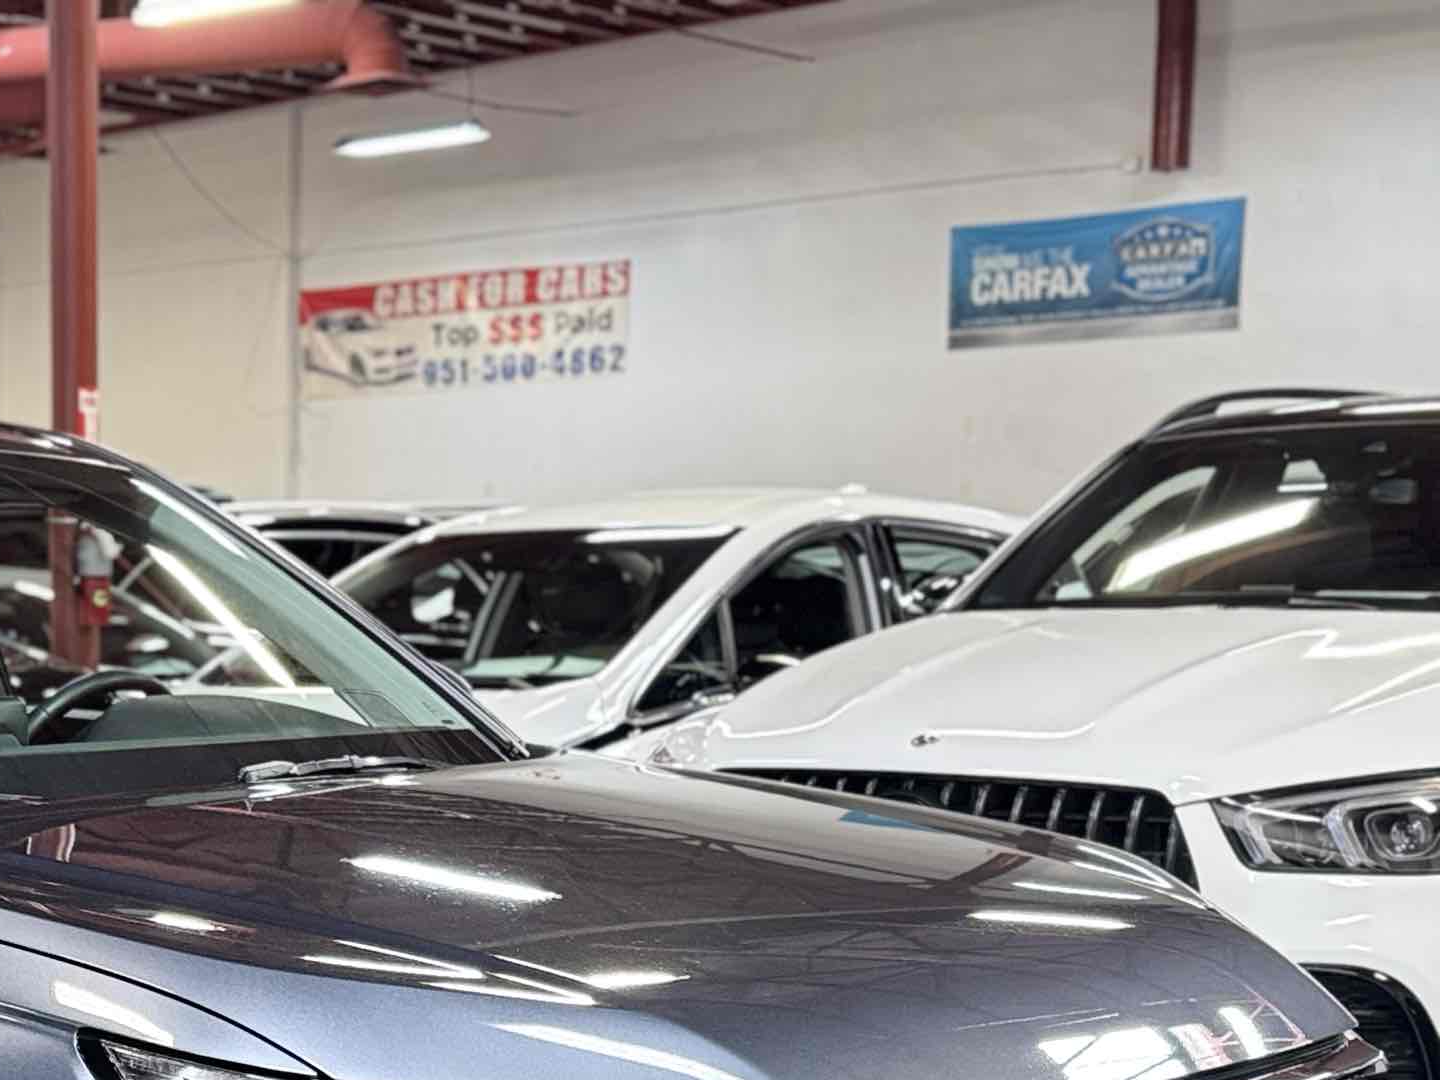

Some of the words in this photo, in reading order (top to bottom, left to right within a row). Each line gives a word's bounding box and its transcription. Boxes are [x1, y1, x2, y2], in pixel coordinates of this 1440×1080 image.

[373, 277, 458, 319] CASH
[464, 270, 525, 309] FOR
[538, 261, 628, 301] CARS
[970, 262, 1090, 305] CARFAX
[432, 322, 480, 348] Top
[553, 306, 614, 336] Paid
